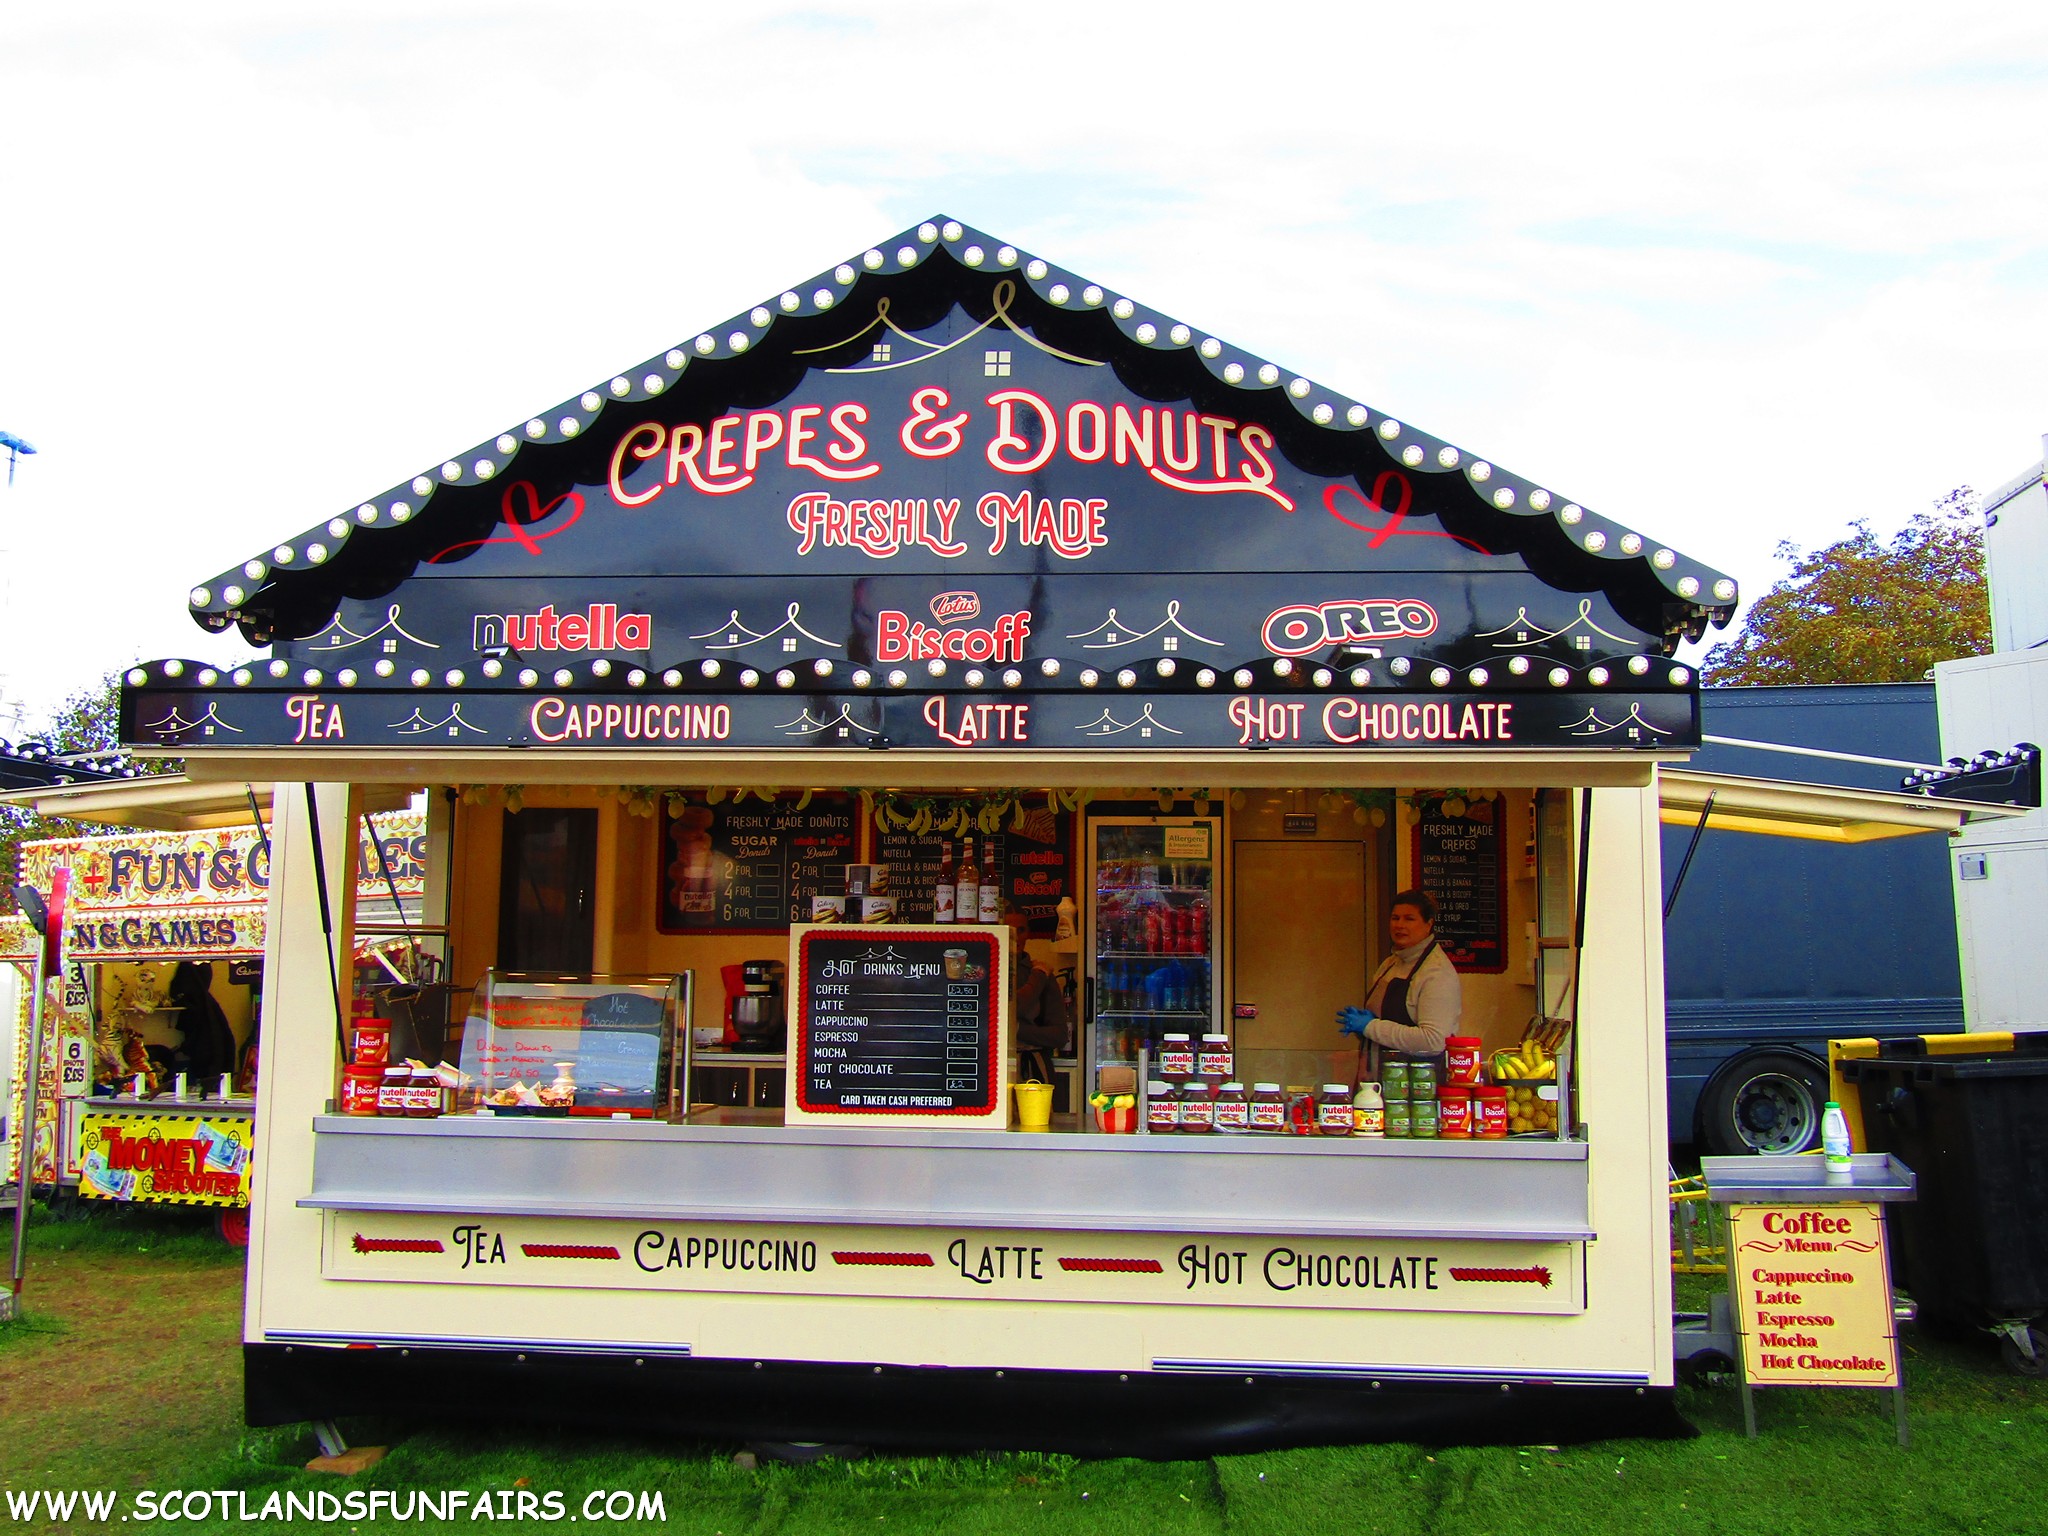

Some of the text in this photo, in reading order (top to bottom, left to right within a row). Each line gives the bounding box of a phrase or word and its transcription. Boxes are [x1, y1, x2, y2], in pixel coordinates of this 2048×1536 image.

[608, 387, 1295, 512] CREPES & DONUTS
[787, 489, 1109, 559] FRESHLY MADE
[937, 596, 976, 617] Lotus
[472, 602, 653, 652] nutella
[1261, 597, 1440, 657] OREO
[877, 609, 1032, 663] Biscoff
[285, 696, 1513, 745] TEA CAPPUCCINO LATTE HOT CHOCOLATE
[725, 813, 850, 831] FRESHLY MADE DONUTS
[1423, 824, 1494, 838] FRESHLY MADE
[731, 835, 778, 847] SUGAR
[883, 836, 944, 847] LEMON & SUGAR
[1441, 839, 1476, 852] CREPES
[735, 846, 772, 859] Donuts
[802, 846, 839, 859] Donuts
[882, 849, 912, 859] NUTELLA
[1010, 850, 1065, 865] nutella
[724, 861, 752, 879] 2 FOR
[791, 861, 820, 880] 2 FOR
[886, 862, 911, 872] UTELLA
[914, 862, 921, 872] &
[887, 875, 911, 885] UTELLA
[914, 875, 920, 885] &
[1013, 878, 1063, 896] Biscoff
[723, 882, 752, 900] 4 FOR
[791, 882, 801, 900] 4
[888, 889, 913, 899] UTELLA
[917, 889, 923, 899] &
[723, 903, 732, 921] 6
[734, 907, 751, 919] FOR
[790, 903, 812, 922] 6 FO
[70, 967, 82, 982] 3
[822, 959, 941, 979] HOT DRINKS MENU
[815, 984, 850, 995] COFFEE
[608, 996, 629, 1014] Hot
[815, 1000, 844, 1010] LATTE
[815, 1016, 868, 1027] CAPPUCCINO
[814, 1032, 859, 1042] ESPRESSO
[68, 1043, 81, 1059] 6
[814, 1047, 847, 1058] MOCHA
[1163, 1054, 1192, 1063] nutella
[1201, 1054, 1231, 1064] nutella
[1450, 1056, 1471, 1066] Biscoff
[813, 1063, 894, 1075] HOT CHOCOLATE
[813, 1079, 832, 1089] TEA
[381, 1087, 407, 1096] nutell
[407, 1088, 437, 1097] nutella
[840, 1095, 952, 1106] CARD TAKEN CASH PREFERRED
[1148, 1102, 1177, 1111] nutella
[1182, 1103, 1213, 1112] nutella
[1216, 1103, 1246, 1113] nutella
[1253, 1104, 1283, 1114] nutella
[1322, 1105, 1352, 1114] nutella
[1442, 1106, 1465, 1116] Biscoff
[101, 1126, 122, 1140] THE
[108, 1137, 214, 1173] MONEY
[152, 1171, 241, 1197] SHOOTER
[1762, 1211, 1852, 1235] Coffee
[1784, 1238, 1833, 1252] Menu
[452, 1224, 1439, 1291] TEA CAPPUCCINO LATTE HOT CHOCOLATE
[1752, 1268, 1854, 1286] Cappuccino
[1754, 1289, 1802, 1305] Latte
[1756, 1311, 1834, 1329] Espresso
[1758, 1333, 1818, 1348] Mocha
[1761, 1354, 1886, 1371] Hot Chocolate
